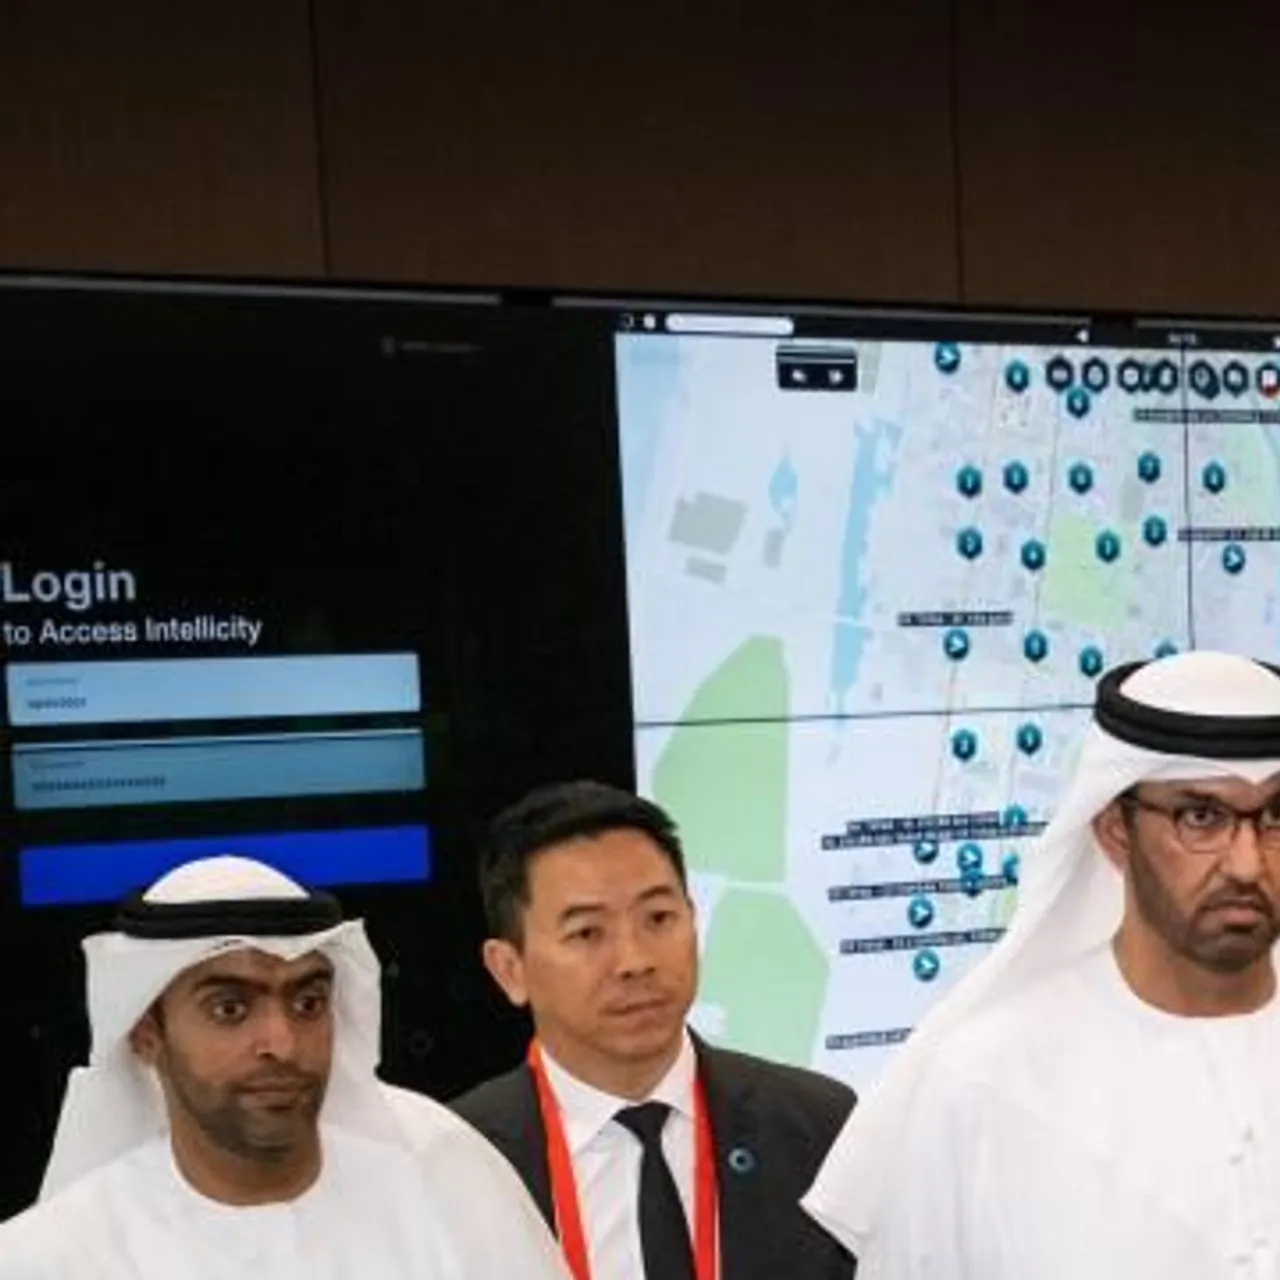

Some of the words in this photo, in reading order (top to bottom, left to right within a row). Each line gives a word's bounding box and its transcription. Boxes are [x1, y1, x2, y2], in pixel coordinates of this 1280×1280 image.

[1, 561, 136, 610] Login
[3, 621, 31, 645] to
[39, 618, 137, 644] Access
[145, 615, 262, 646] Intellicity
